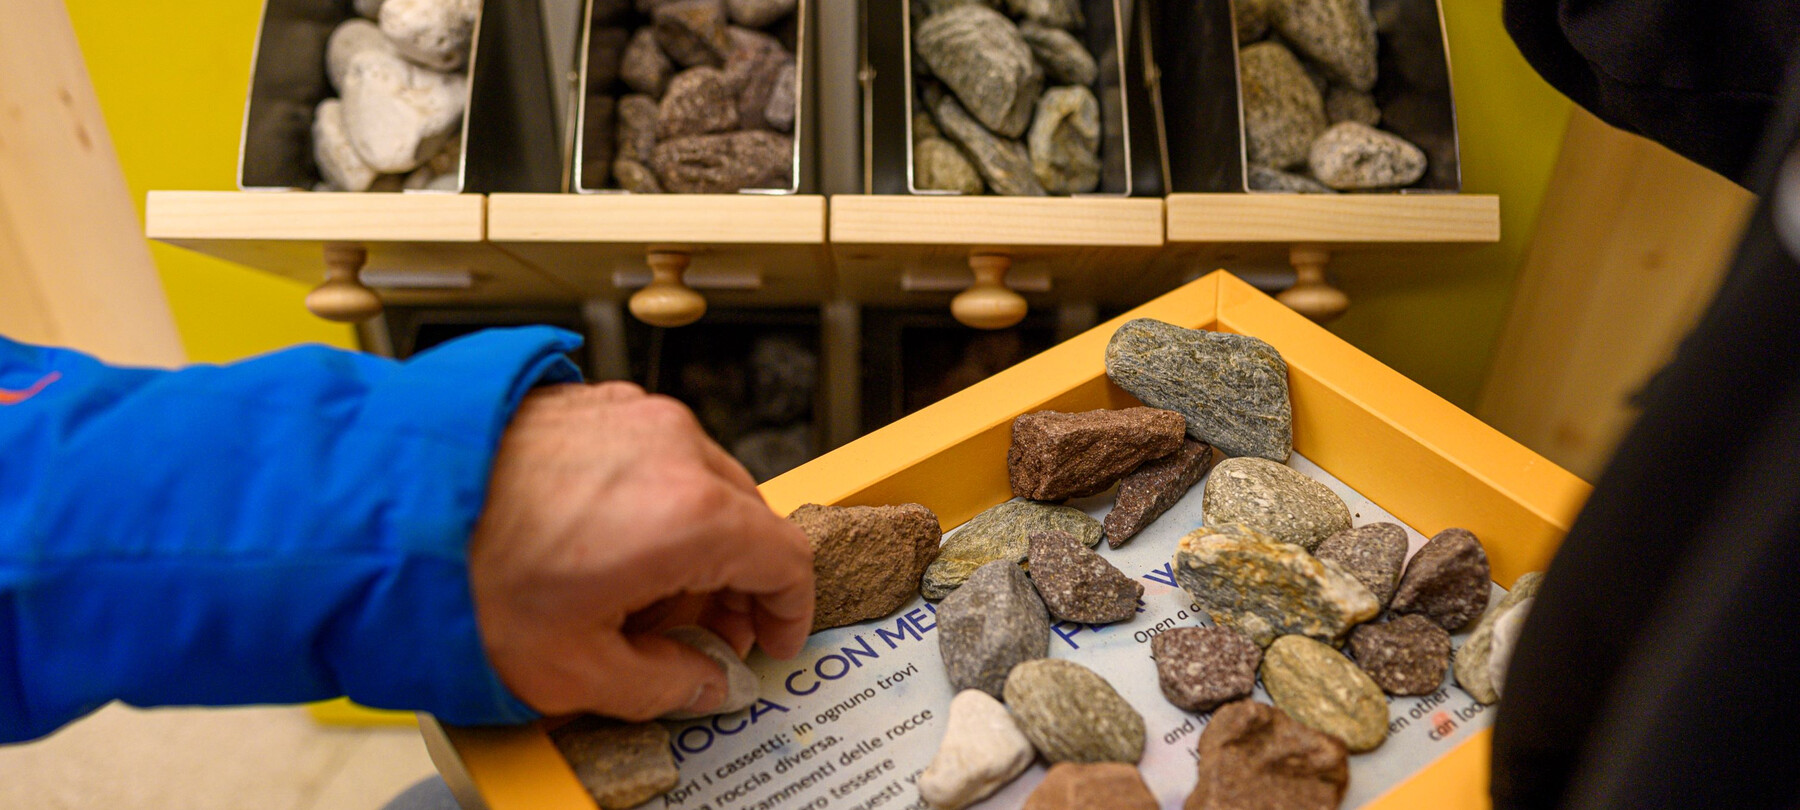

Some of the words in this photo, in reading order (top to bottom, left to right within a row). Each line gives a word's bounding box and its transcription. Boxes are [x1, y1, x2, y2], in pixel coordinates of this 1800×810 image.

[1134, 617, 1176, 643] Open
[1177, 610, 1189, 620] a
[670, 698, 790, 770] IOCA
[785, 635, 880, 696] CON
[1409, 687, 1450, 721] other
[1428, 717, 1459, 742] can
[1453, 701, 1485, 722] loo
[663, 779, 702, 808] Apri
[716, 733, 791, 779] cassetti:
[793, 722, 813, 736] in
[815, 687, 876, 724] ognuno
[877, 662, 919, 690] trovi
[1164, 718, 1195, 745] and
[716, 772, 771, 807] roccia
[775, 735, 844, 774] diversa.
[740, 761, 836, 810] ammenti
[839, 737, 884, 767] delle
[886, 709, 933, 741] rocce
[830, 759, 895, 800] tessere
